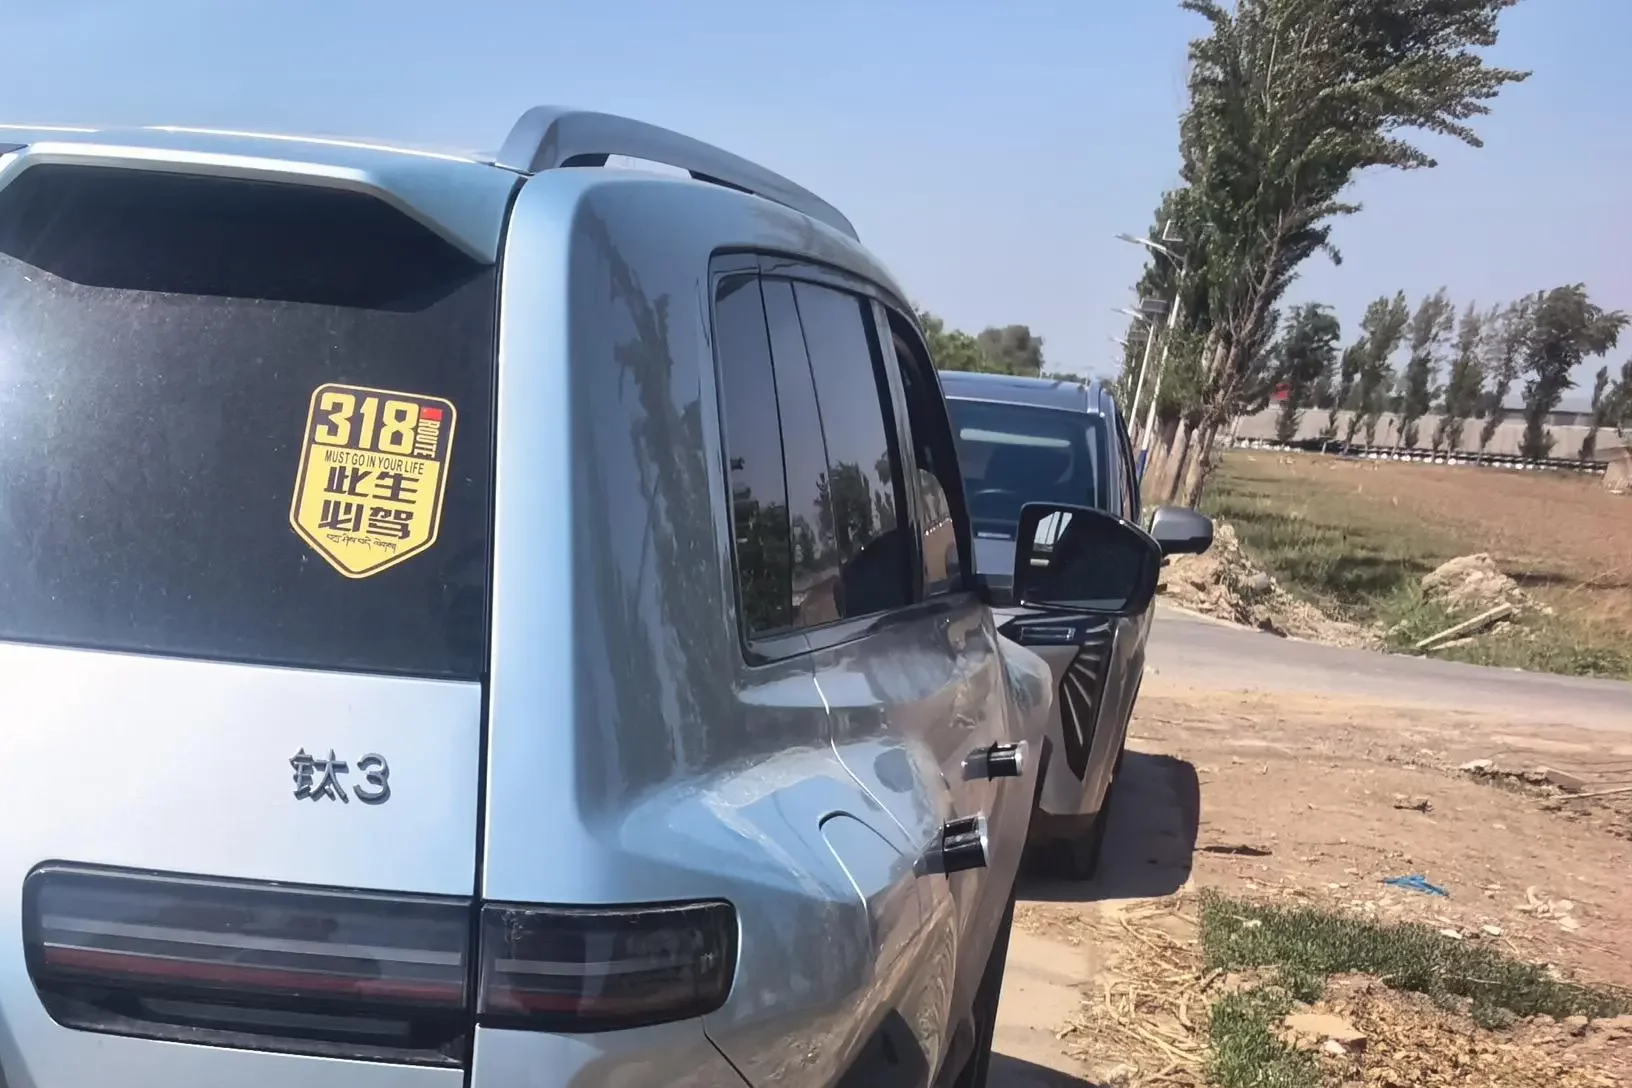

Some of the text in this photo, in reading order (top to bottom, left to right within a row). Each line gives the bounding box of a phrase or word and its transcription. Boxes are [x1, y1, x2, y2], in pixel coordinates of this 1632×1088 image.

[315, 392, 419, 455] 318
[414, 418, 441, 458] ROUTE
[325, 450, 424, 475] MUST GO IN YOUR LIFE
[324, 465, 419, 504] 此生
[318, 500, 414, 539] 必驾
[289, 747, 391, 805] 钛3
